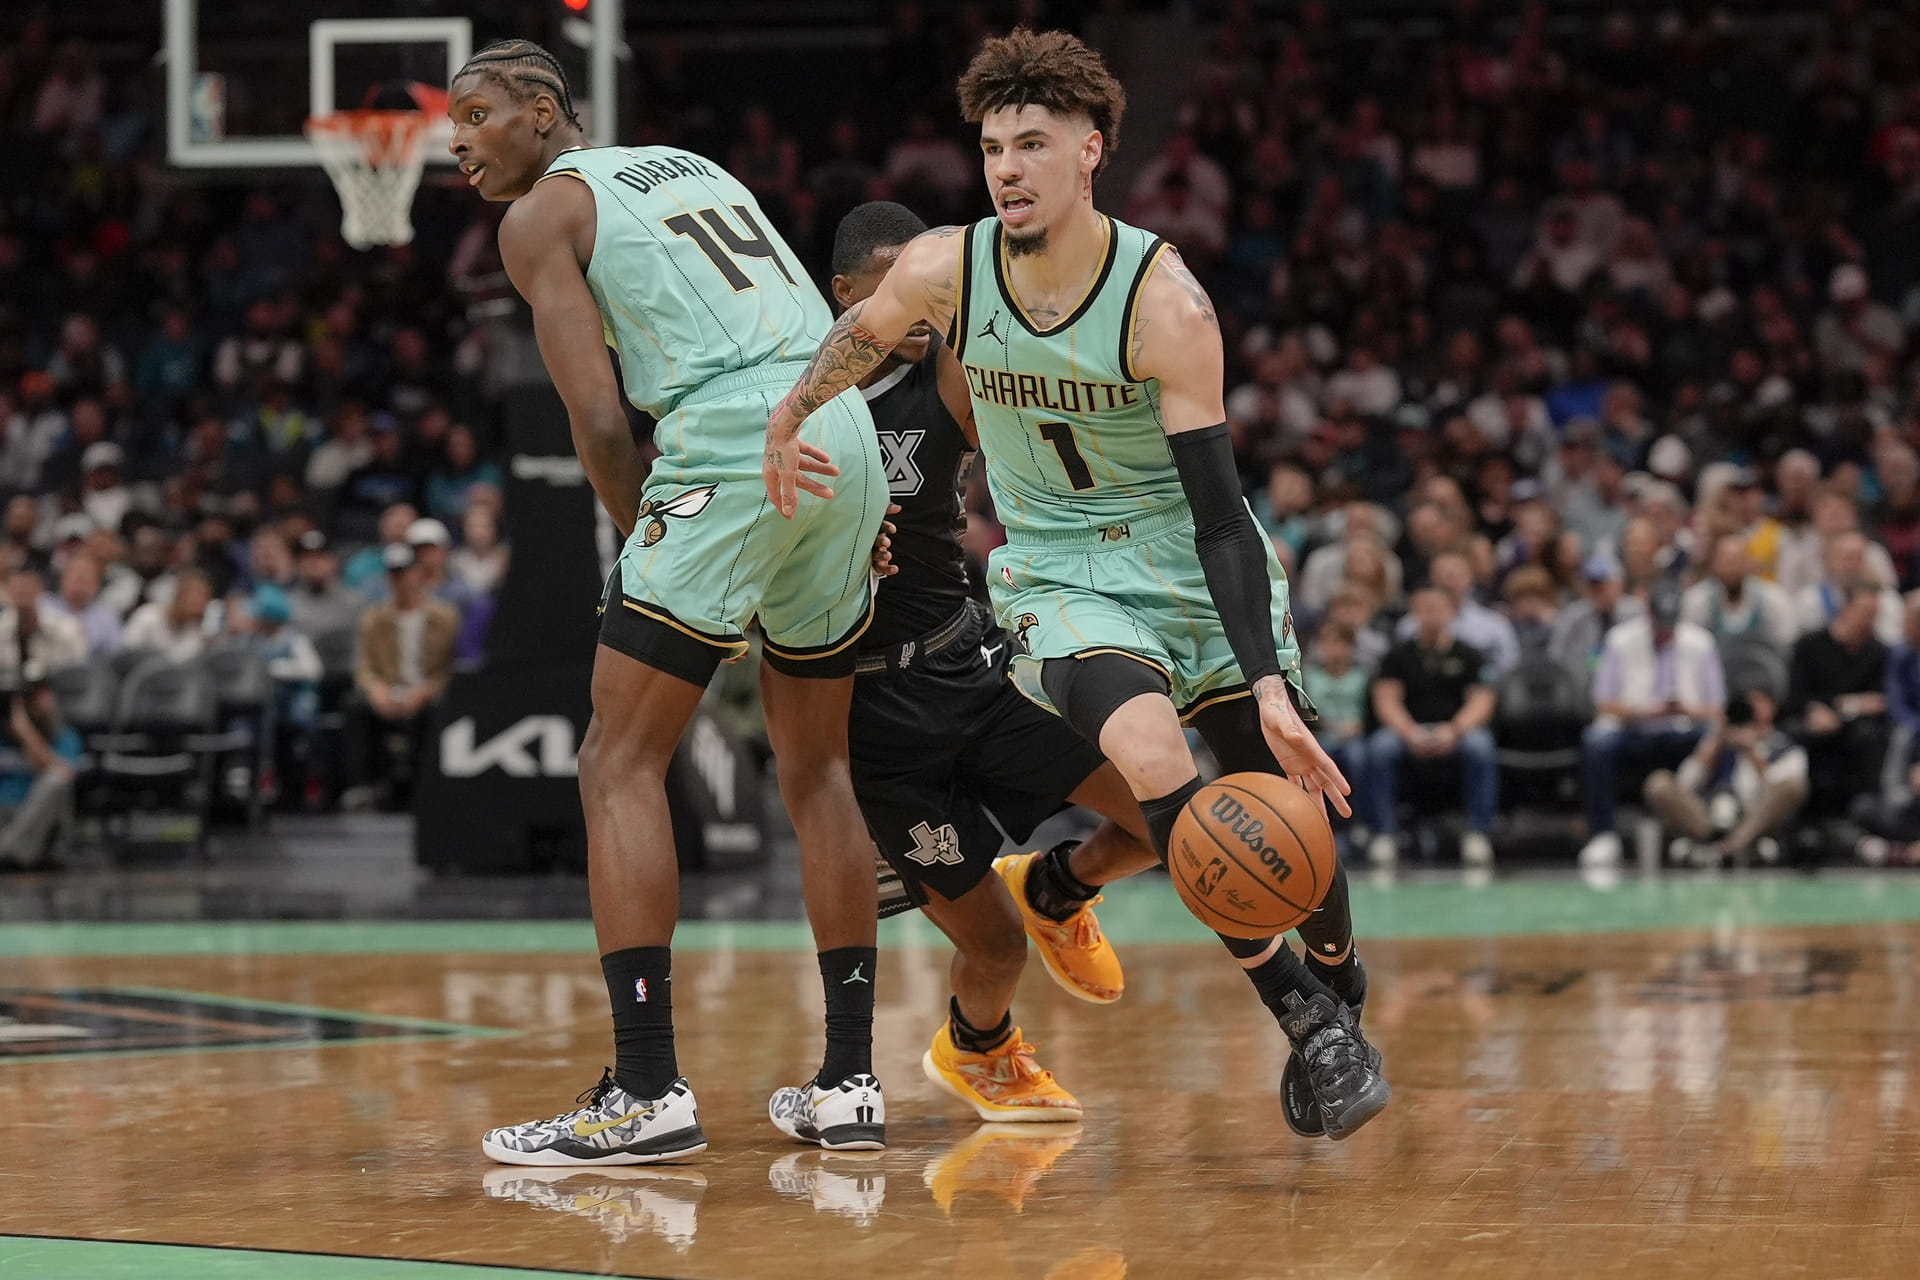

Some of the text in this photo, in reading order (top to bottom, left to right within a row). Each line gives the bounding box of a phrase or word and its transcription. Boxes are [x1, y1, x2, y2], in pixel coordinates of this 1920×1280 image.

[661, 204, 800, 294] 14
[964, 364, 1139, 413] CHARLOTTE
[1036, 421, 1099, 493] 1
[1209, 792, 1294, 885] Wilson
